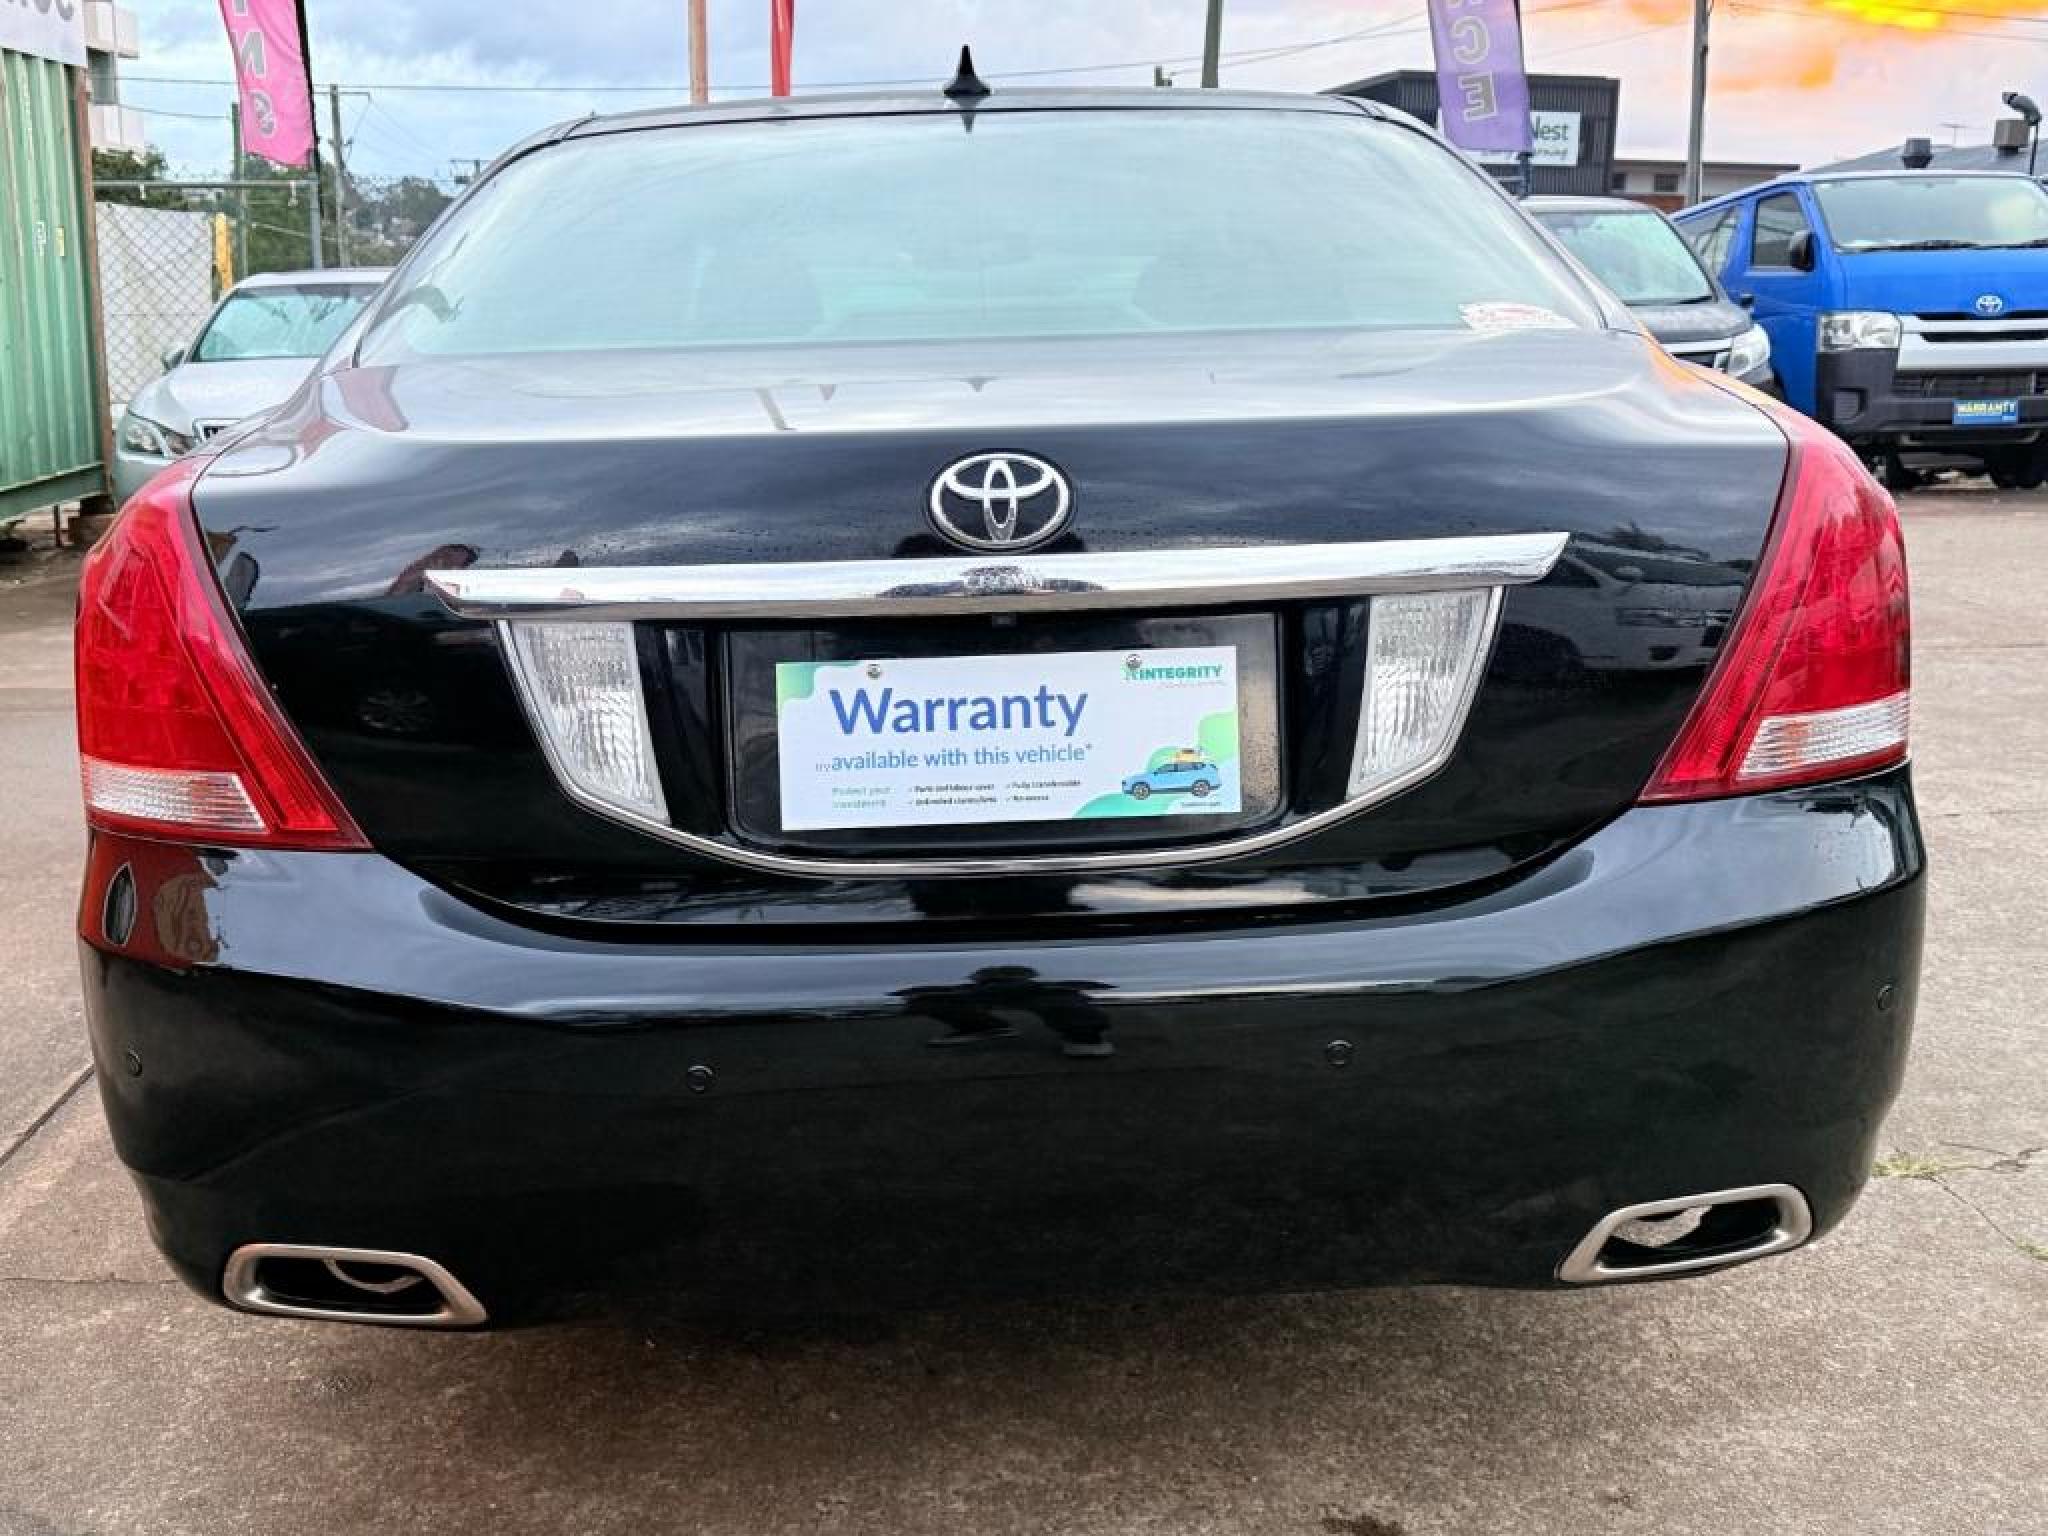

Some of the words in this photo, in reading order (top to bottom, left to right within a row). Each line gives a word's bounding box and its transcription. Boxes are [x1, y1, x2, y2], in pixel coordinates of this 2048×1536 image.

[829, 685, 1088, 736] Warranty
[832, 751, 918, 770] available
[924, 748, 967, 766] with
[974, 746, 1009, 765] this
